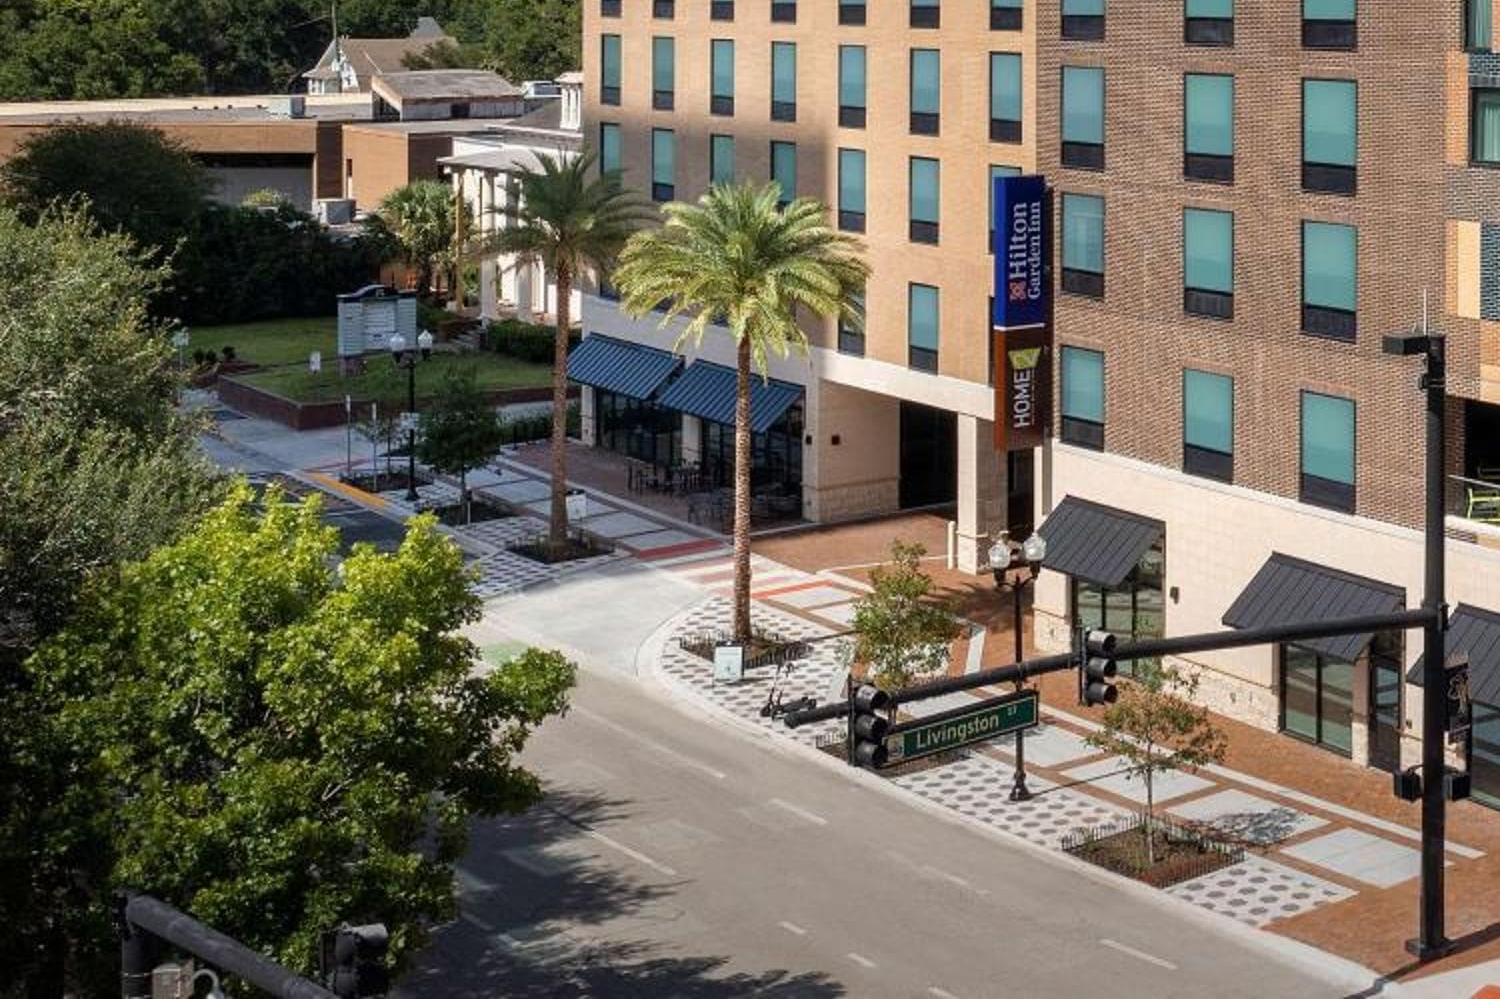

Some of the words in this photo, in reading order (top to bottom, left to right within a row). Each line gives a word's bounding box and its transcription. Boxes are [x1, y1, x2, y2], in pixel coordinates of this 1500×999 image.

[1009, 202, 1027, 279] Hilton
[1027, 201, 1041, 232] Inn
[1027, 234, 1041, 299] Garden
[916, 714, 999, 749] Livingston
